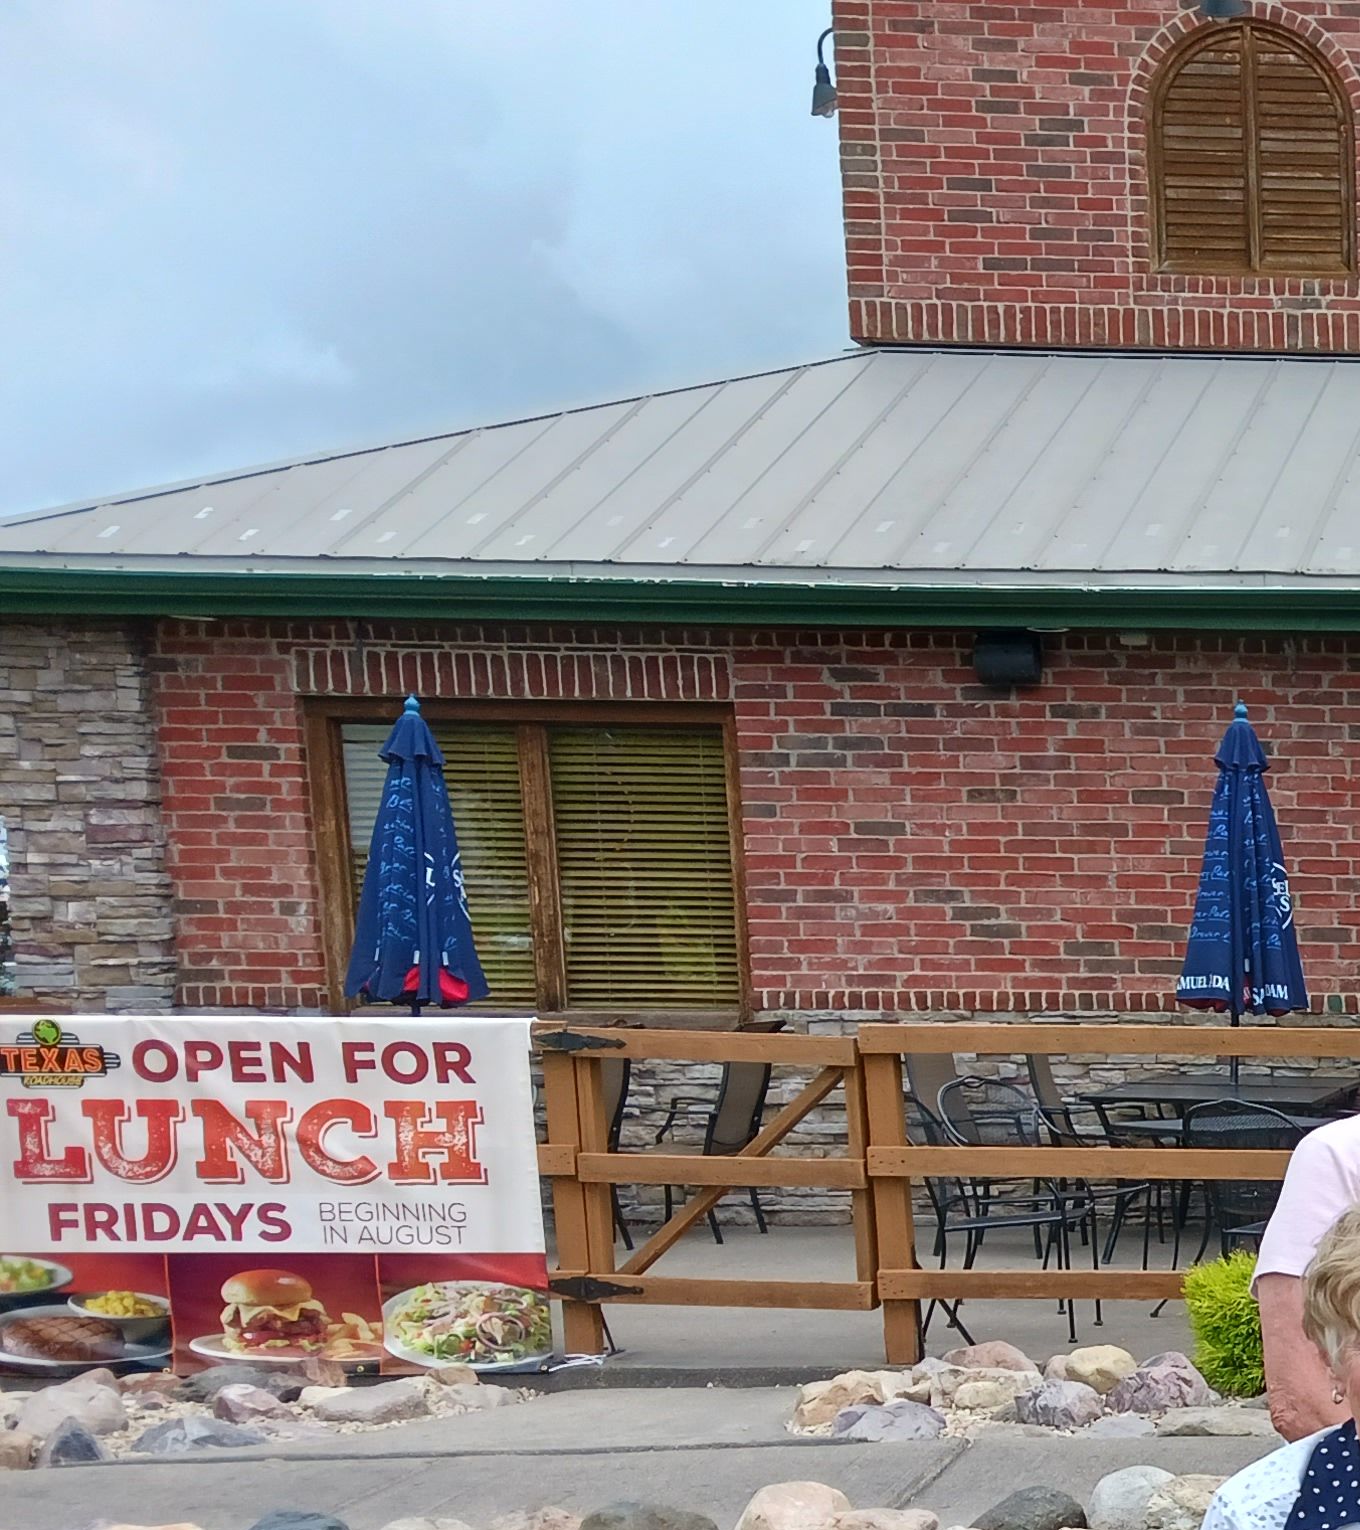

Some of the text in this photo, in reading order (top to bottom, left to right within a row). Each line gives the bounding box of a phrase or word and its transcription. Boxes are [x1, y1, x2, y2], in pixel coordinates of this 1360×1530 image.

[0, 1048, 102, 1073] TEXAS
[132, 1039, 476, 1084] OPEN FOR
[7, 1098, 489, 1186] LUNCH
[48, 1202, 293, 1242] FRIDAYS
[318, 1201, 468, 1223] BEGINNING
[322, 1224, 468, 1246] IN AUGUST
